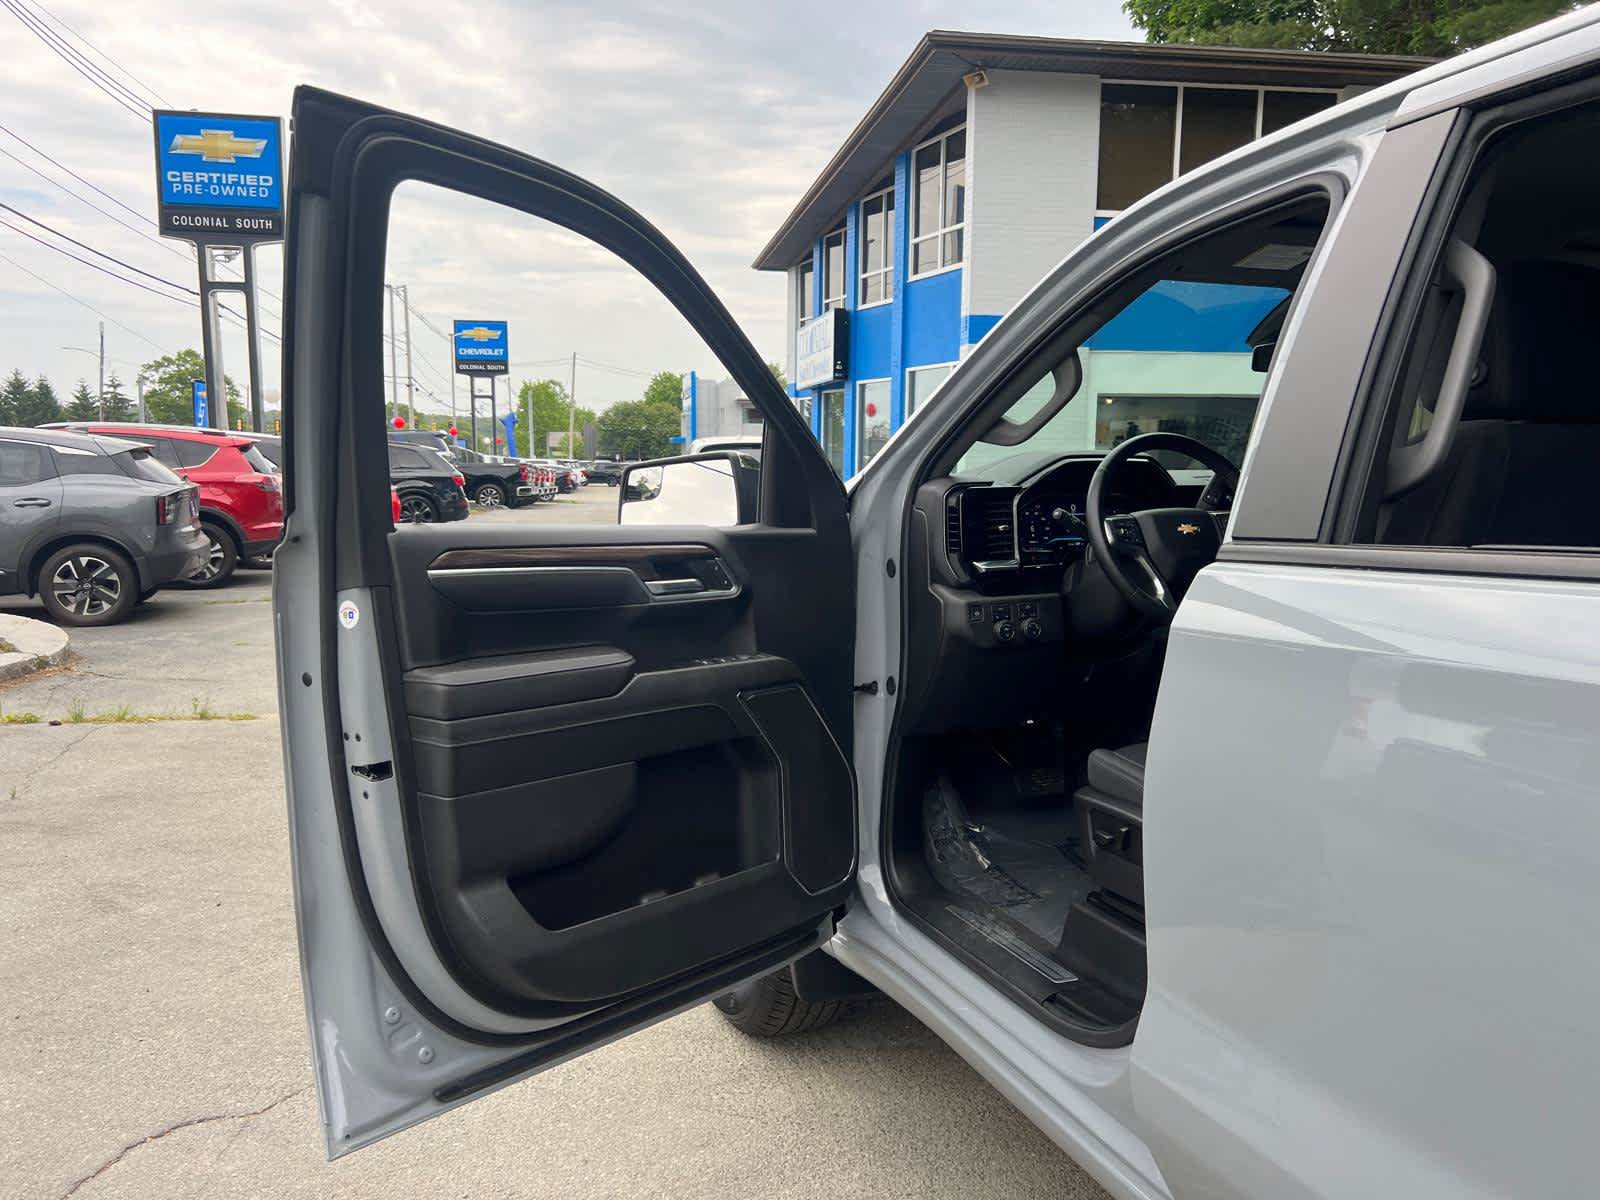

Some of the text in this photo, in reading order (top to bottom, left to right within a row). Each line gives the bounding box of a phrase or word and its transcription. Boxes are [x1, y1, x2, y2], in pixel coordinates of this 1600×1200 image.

[167, 171, 273, 187] CERTIFIED
[172, 183, 269, 198] PRE-OWNED
[172, 215, 273, 230] COLONIAL SOUTH
[458, 347, 504, 356] CHEVROLET
